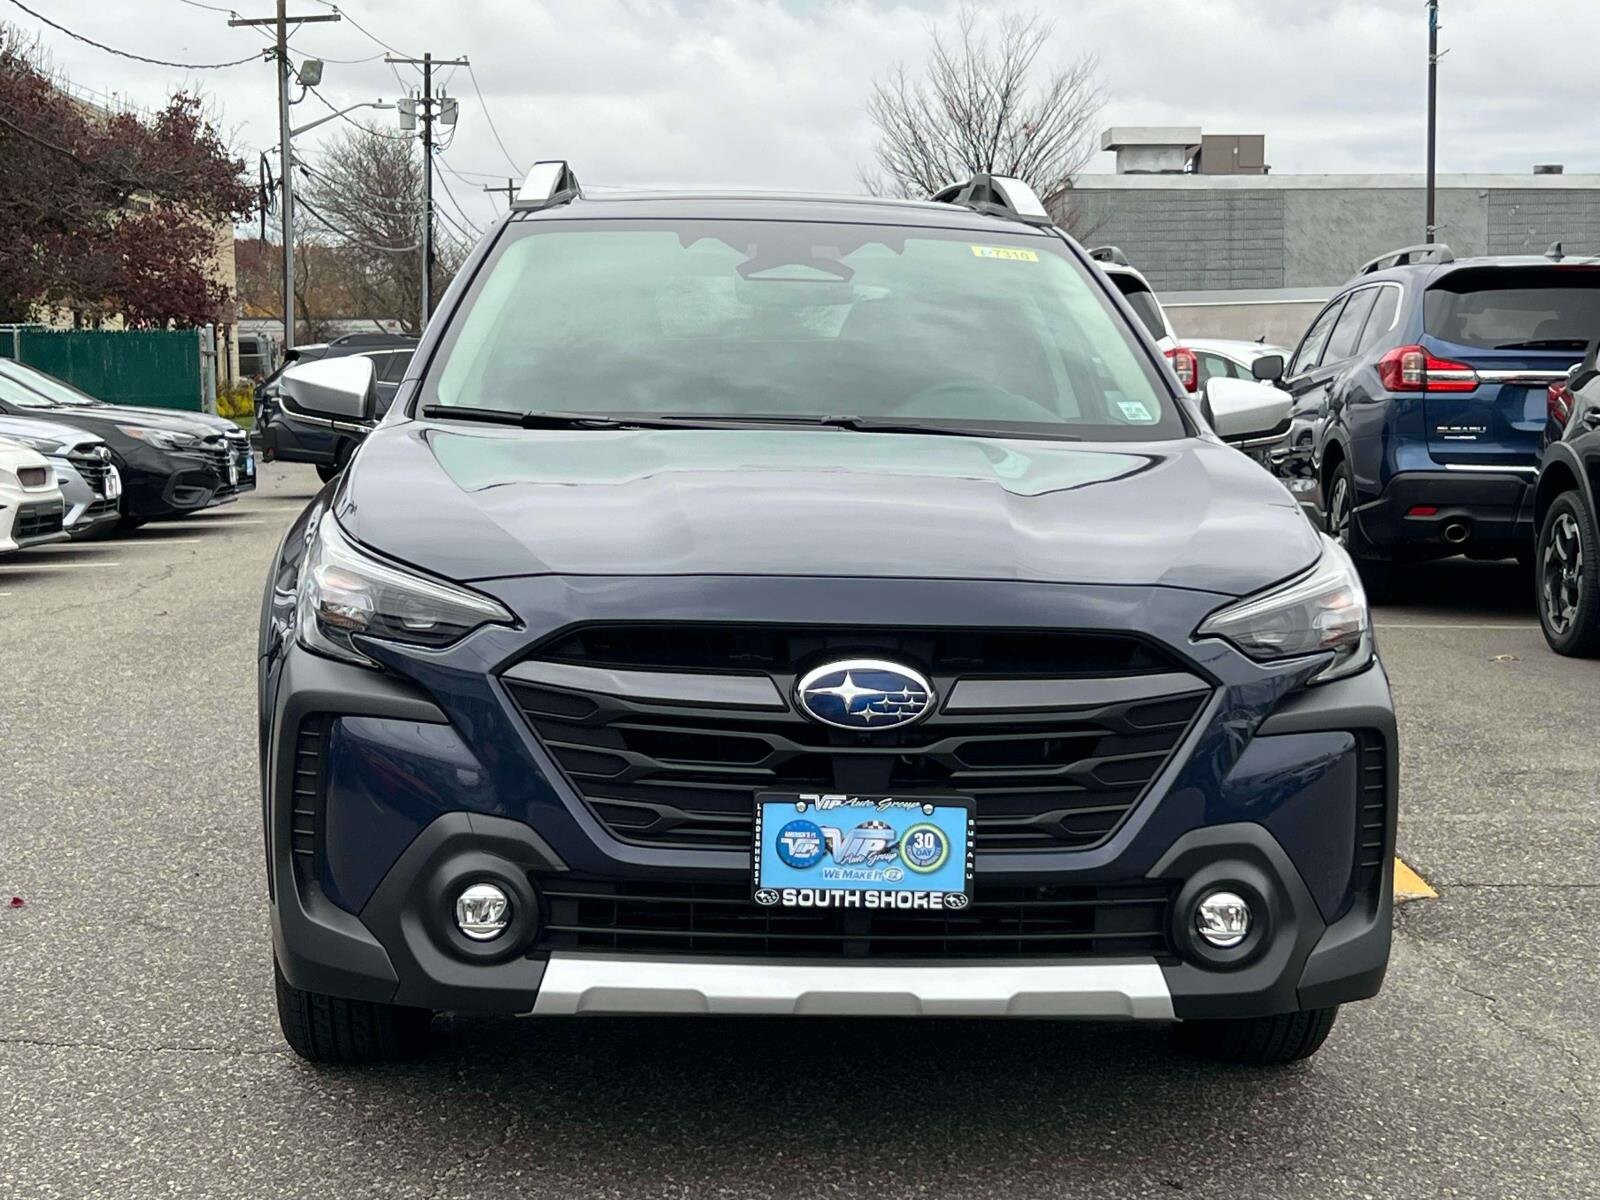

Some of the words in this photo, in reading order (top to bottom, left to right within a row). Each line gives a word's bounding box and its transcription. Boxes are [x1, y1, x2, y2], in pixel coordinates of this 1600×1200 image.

[799, 794, 847, 811] VIP
[842, 797, 875, 809] Auto
[875, 798, 922, 813] Group
[820, 826, 895, 863] VIP
[913, 832, 935, 849] 30
[840, 852, 866, 865] Auto
[915, 848, 932, 857] DAY
[823, 869, 841, 879] WE
[842, 869, 873, 880] MAKE
[782, 888, 860, 908] SOUTH
[864, 890, 944, 909] SHORE
